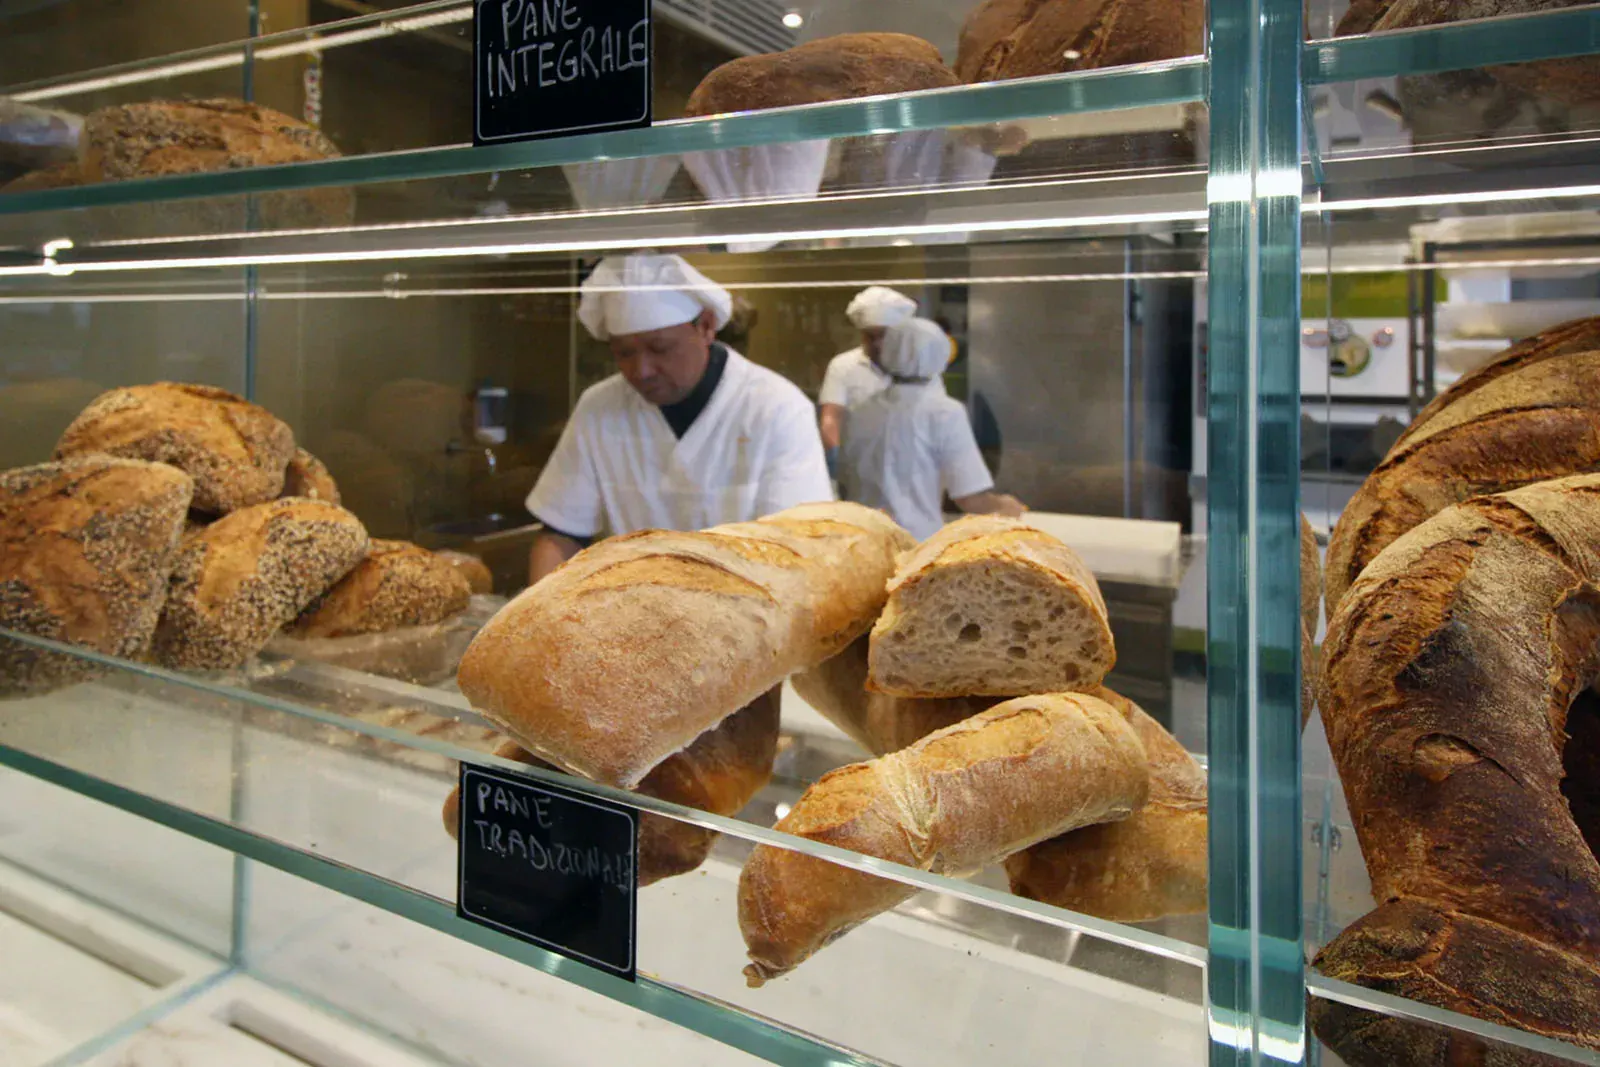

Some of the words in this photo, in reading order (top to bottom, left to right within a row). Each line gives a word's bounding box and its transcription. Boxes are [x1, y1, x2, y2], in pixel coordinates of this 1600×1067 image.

[501, 0, 582, 49] PANE
[487, 18, 649, 98] INTEGRALE
[476, 782, 553, 829] PANE
